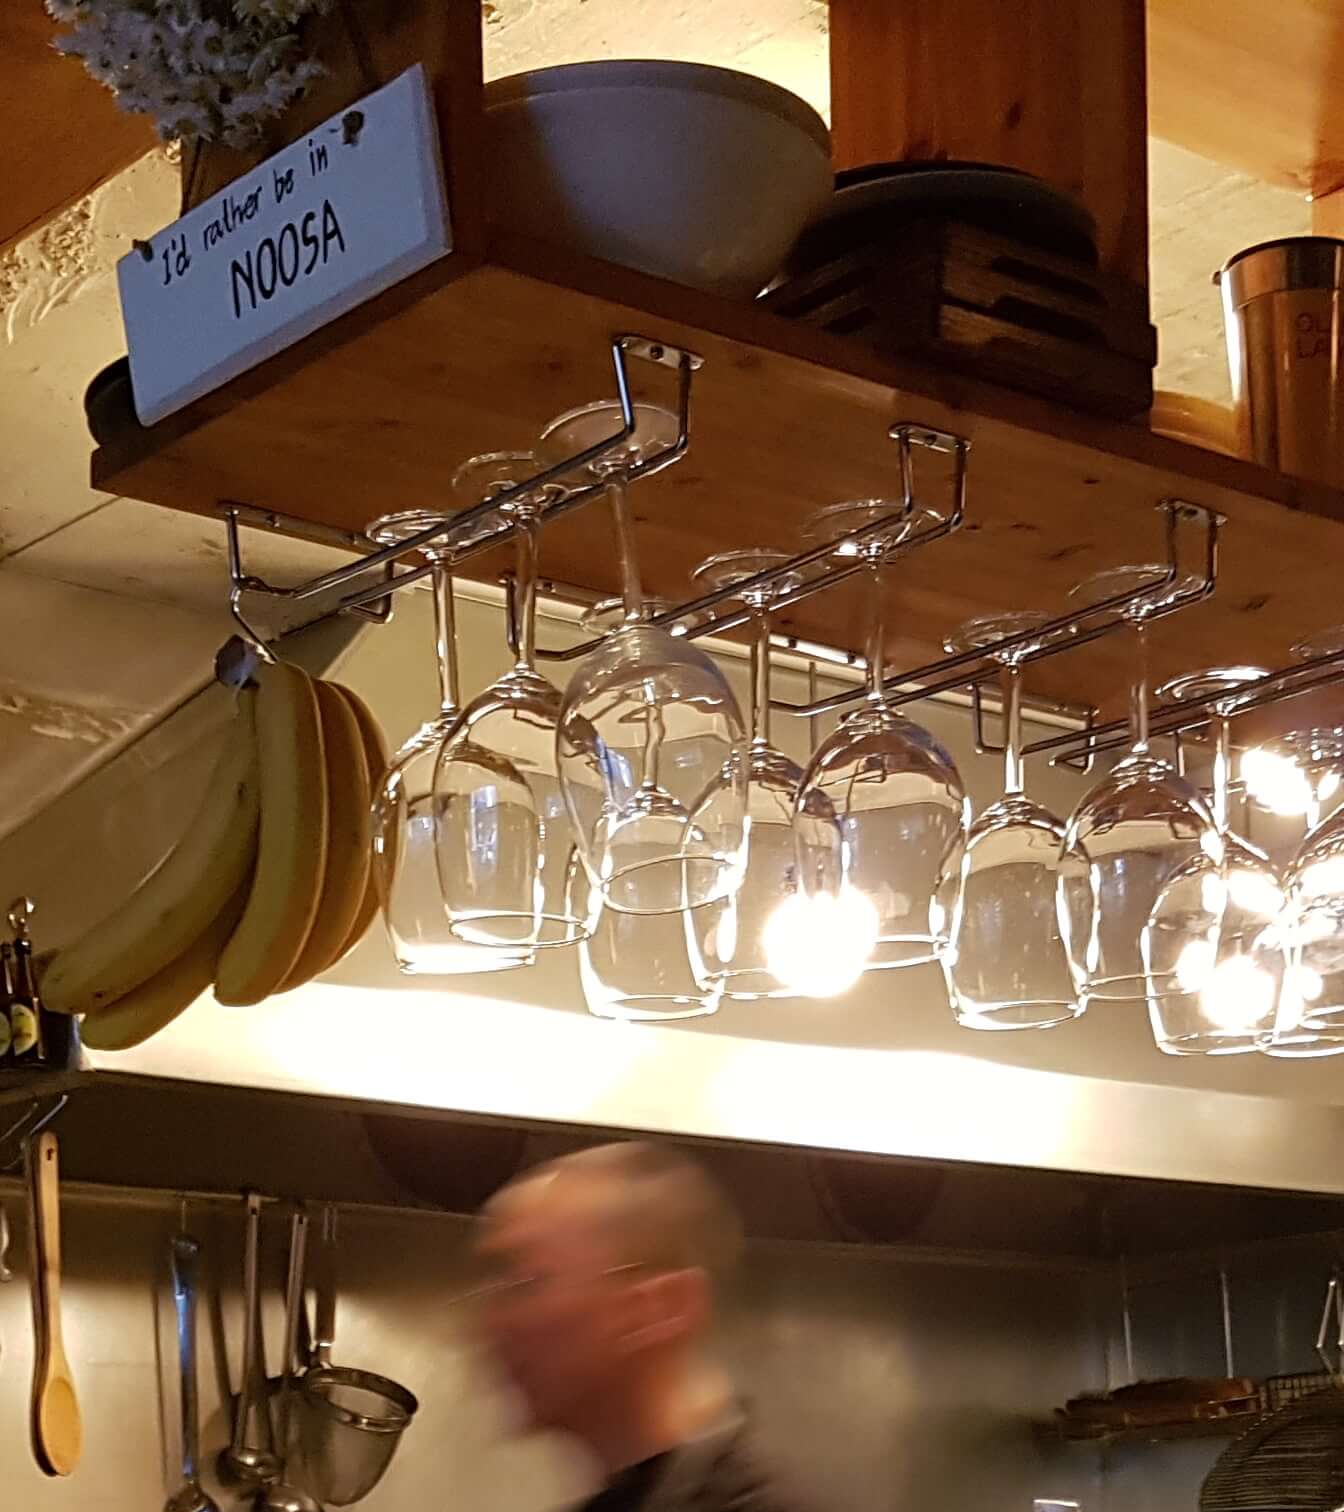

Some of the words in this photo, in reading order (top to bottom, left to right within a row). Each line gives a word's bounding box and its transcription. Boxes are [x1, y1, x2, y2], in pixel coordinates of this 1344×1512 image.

[162, 233, 191, 286] I'd
[203, 185, 263, 251] rather
[274, 168, 295, 204] be
[309, 138, 329, 177] in
[230, 199, 346, 319] NOOSA
